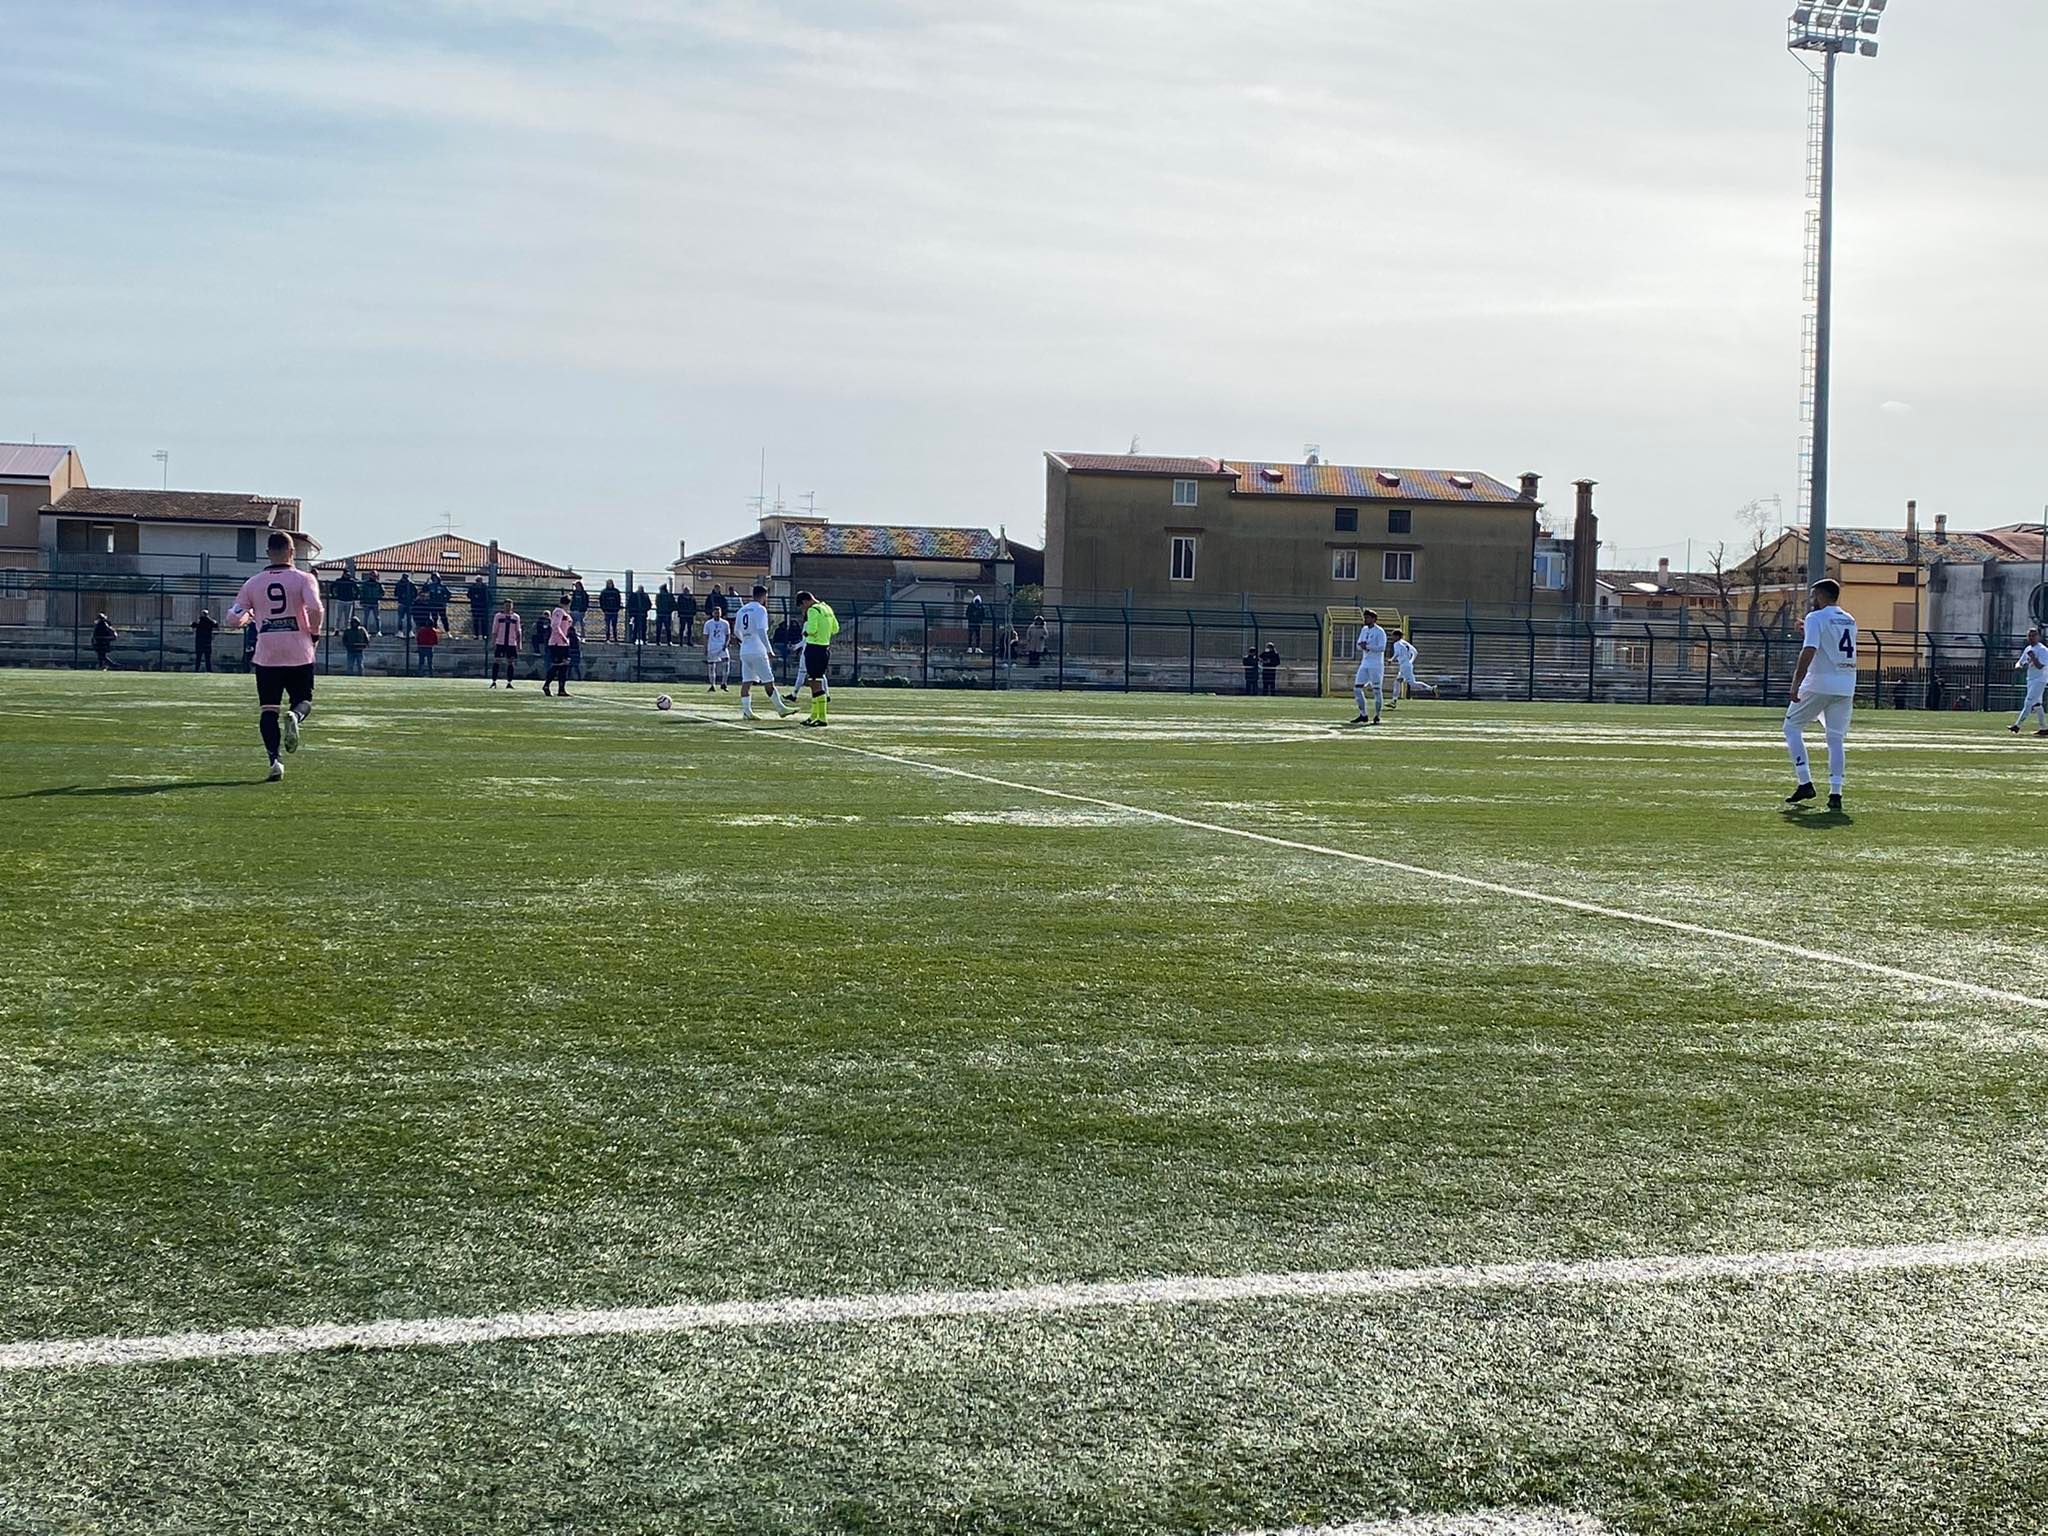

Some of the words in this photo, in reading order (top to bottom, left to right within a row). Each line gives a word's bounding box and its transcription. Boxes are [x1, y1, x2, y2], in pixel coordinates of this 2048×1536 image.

[267, 583, 286, 614] 9
[742, 614, 749, 630] 9
[1839, 629, 1854, 658] 4
